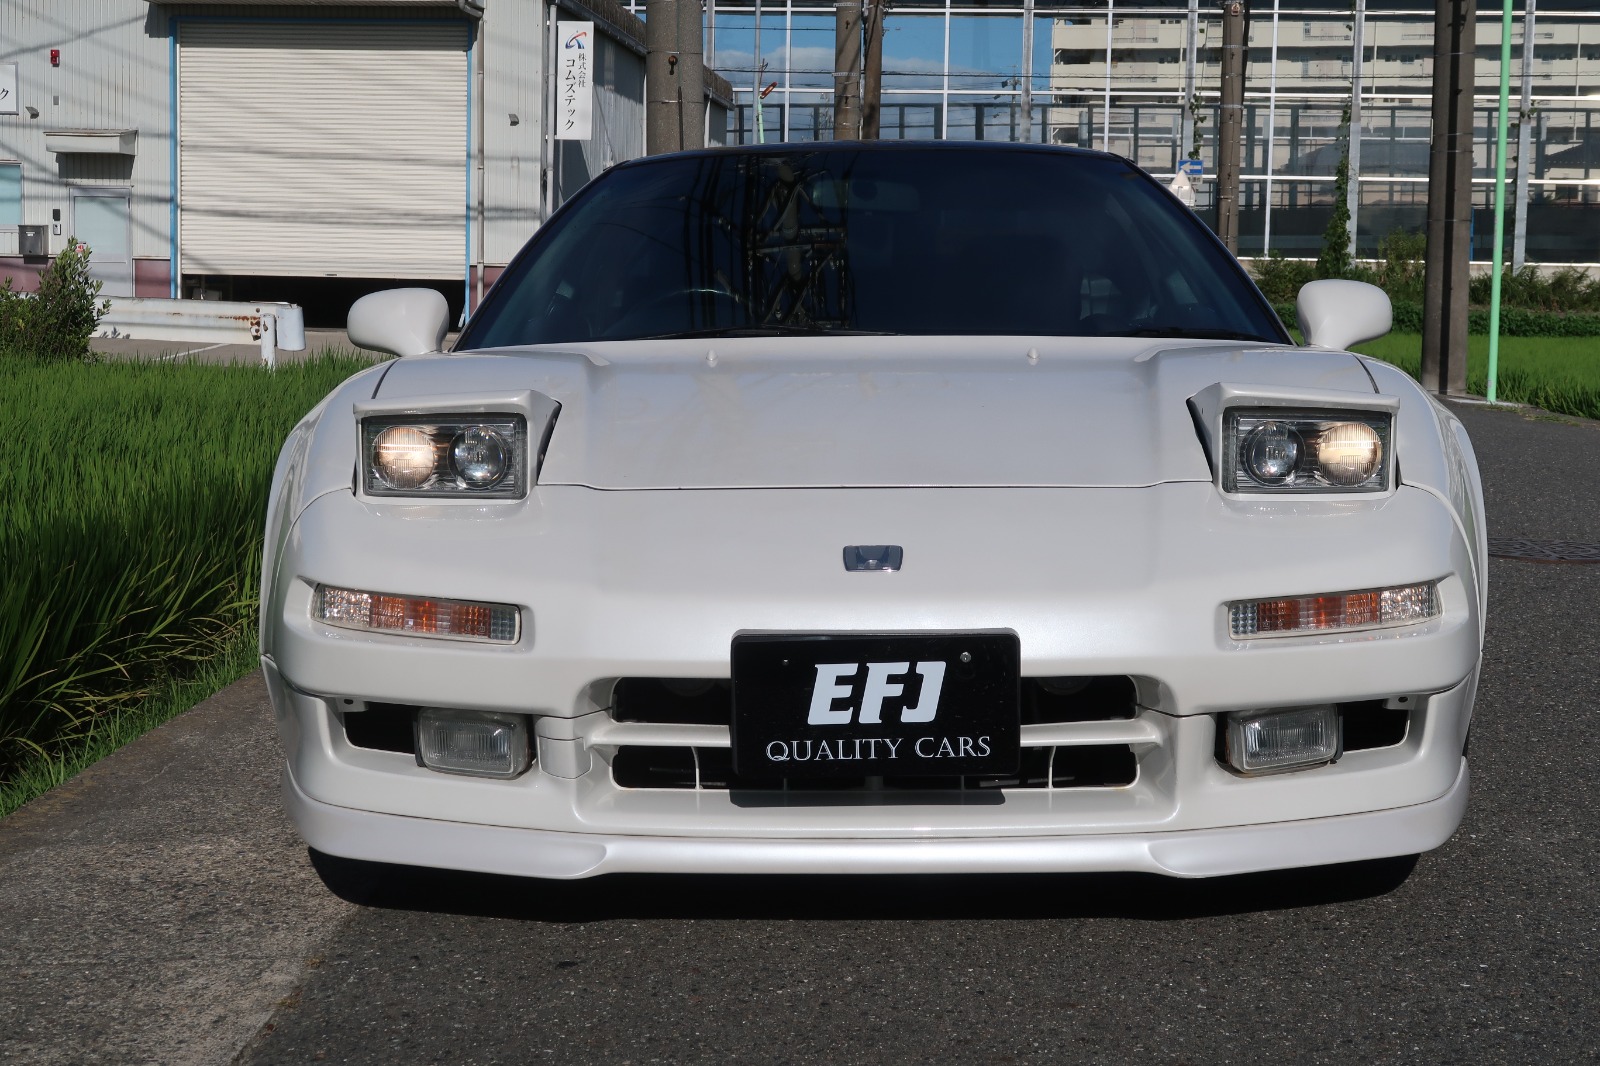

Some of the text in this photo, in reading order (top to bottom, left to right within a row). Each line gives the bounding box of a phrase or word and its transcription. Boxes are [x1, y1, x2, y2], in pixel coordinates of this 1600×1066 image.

[565, 58, 576, 130] コムズテック
[578, 52, 587, 88] 株式会社
[807, 661, 947, 725] EFJ
[766, 736, 991, 761] QUALITY CARS
